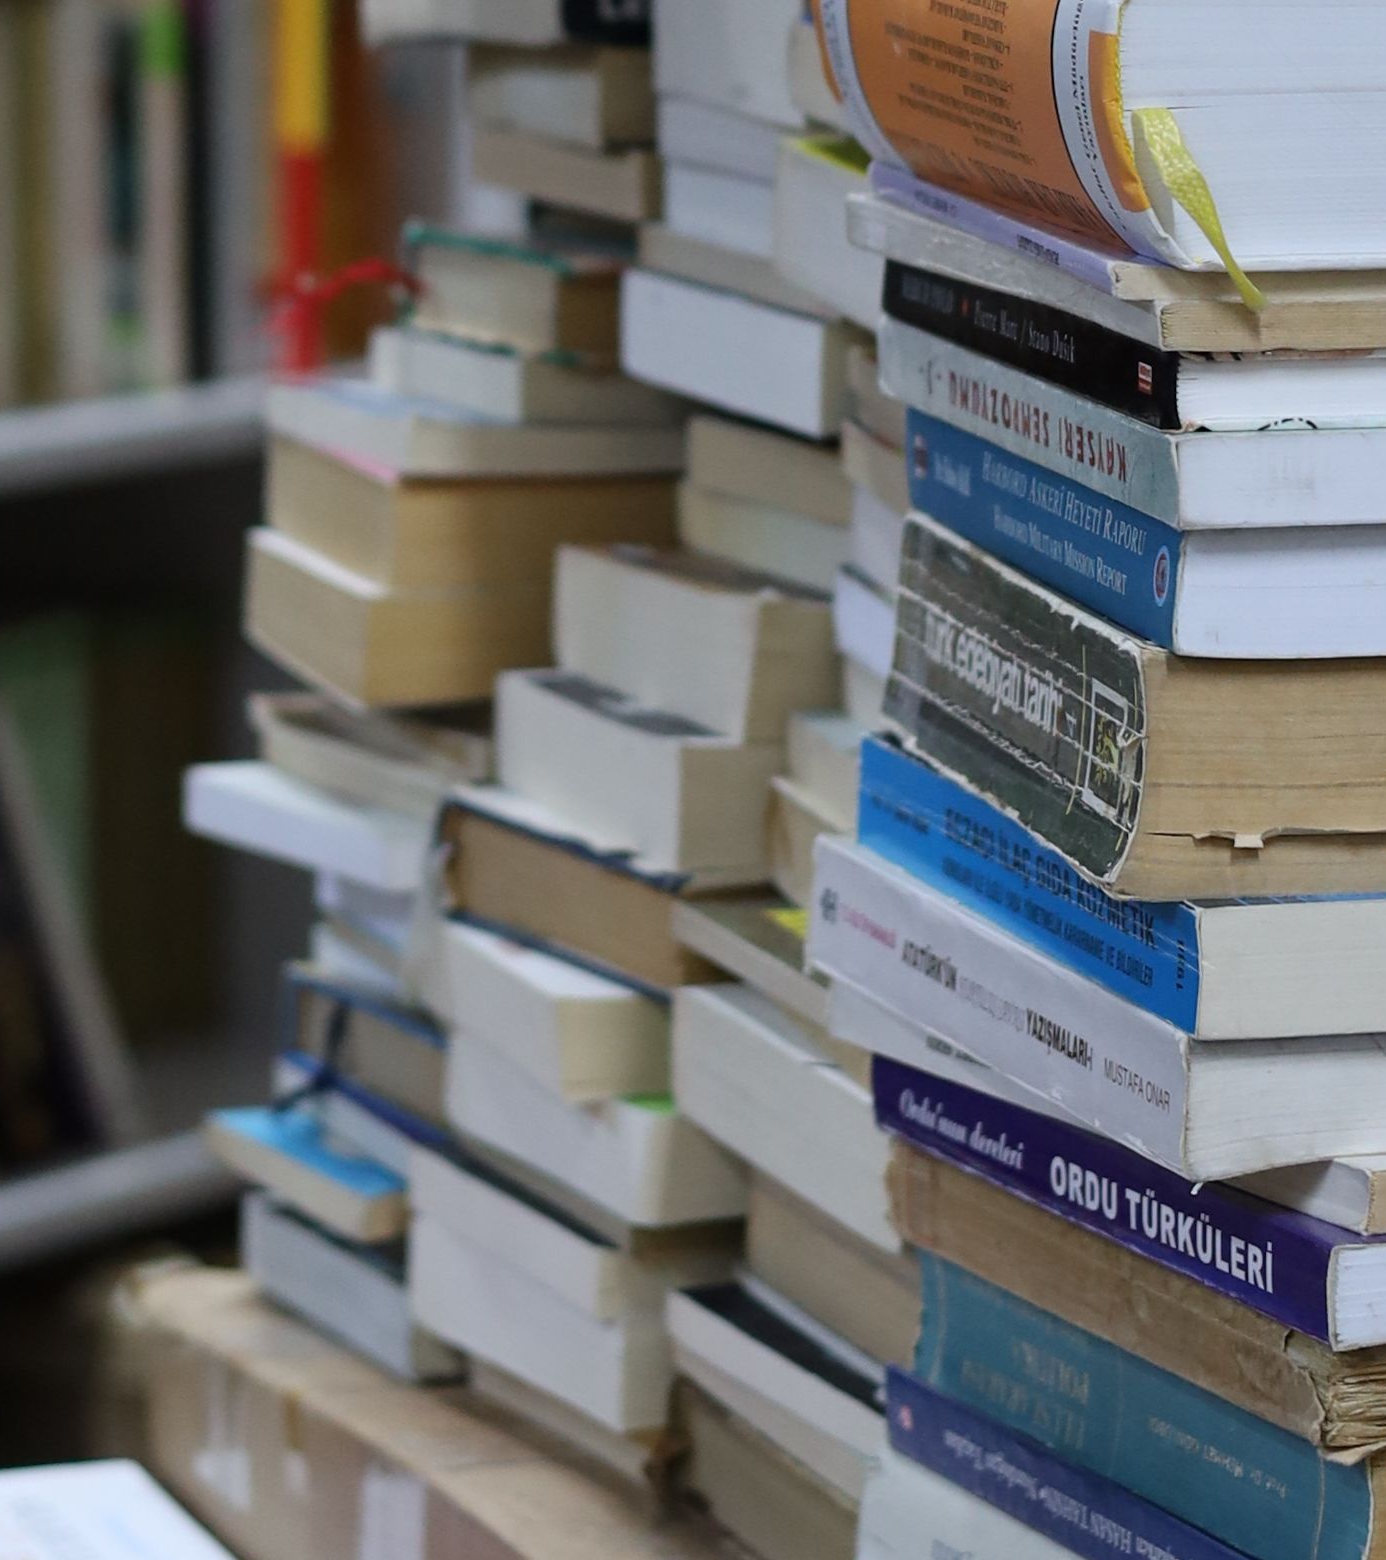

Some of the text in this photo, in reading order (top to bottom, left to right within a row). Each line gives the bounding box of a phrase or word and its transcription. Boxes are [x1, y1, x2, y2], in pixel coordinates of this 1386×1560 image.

[1104, 506, 1148, 556] RAPORU
[1095, 554, 1128, 597] REPORT
[1034, 855, 1074, 904] GIDA
[1103, 1056, 1145, 1101] MUSTAFA
[1145, 1081, 1172, 1114] ONAR
[1050, 1154, 1274, 1295] ORDU TÜRKÜLERİ
